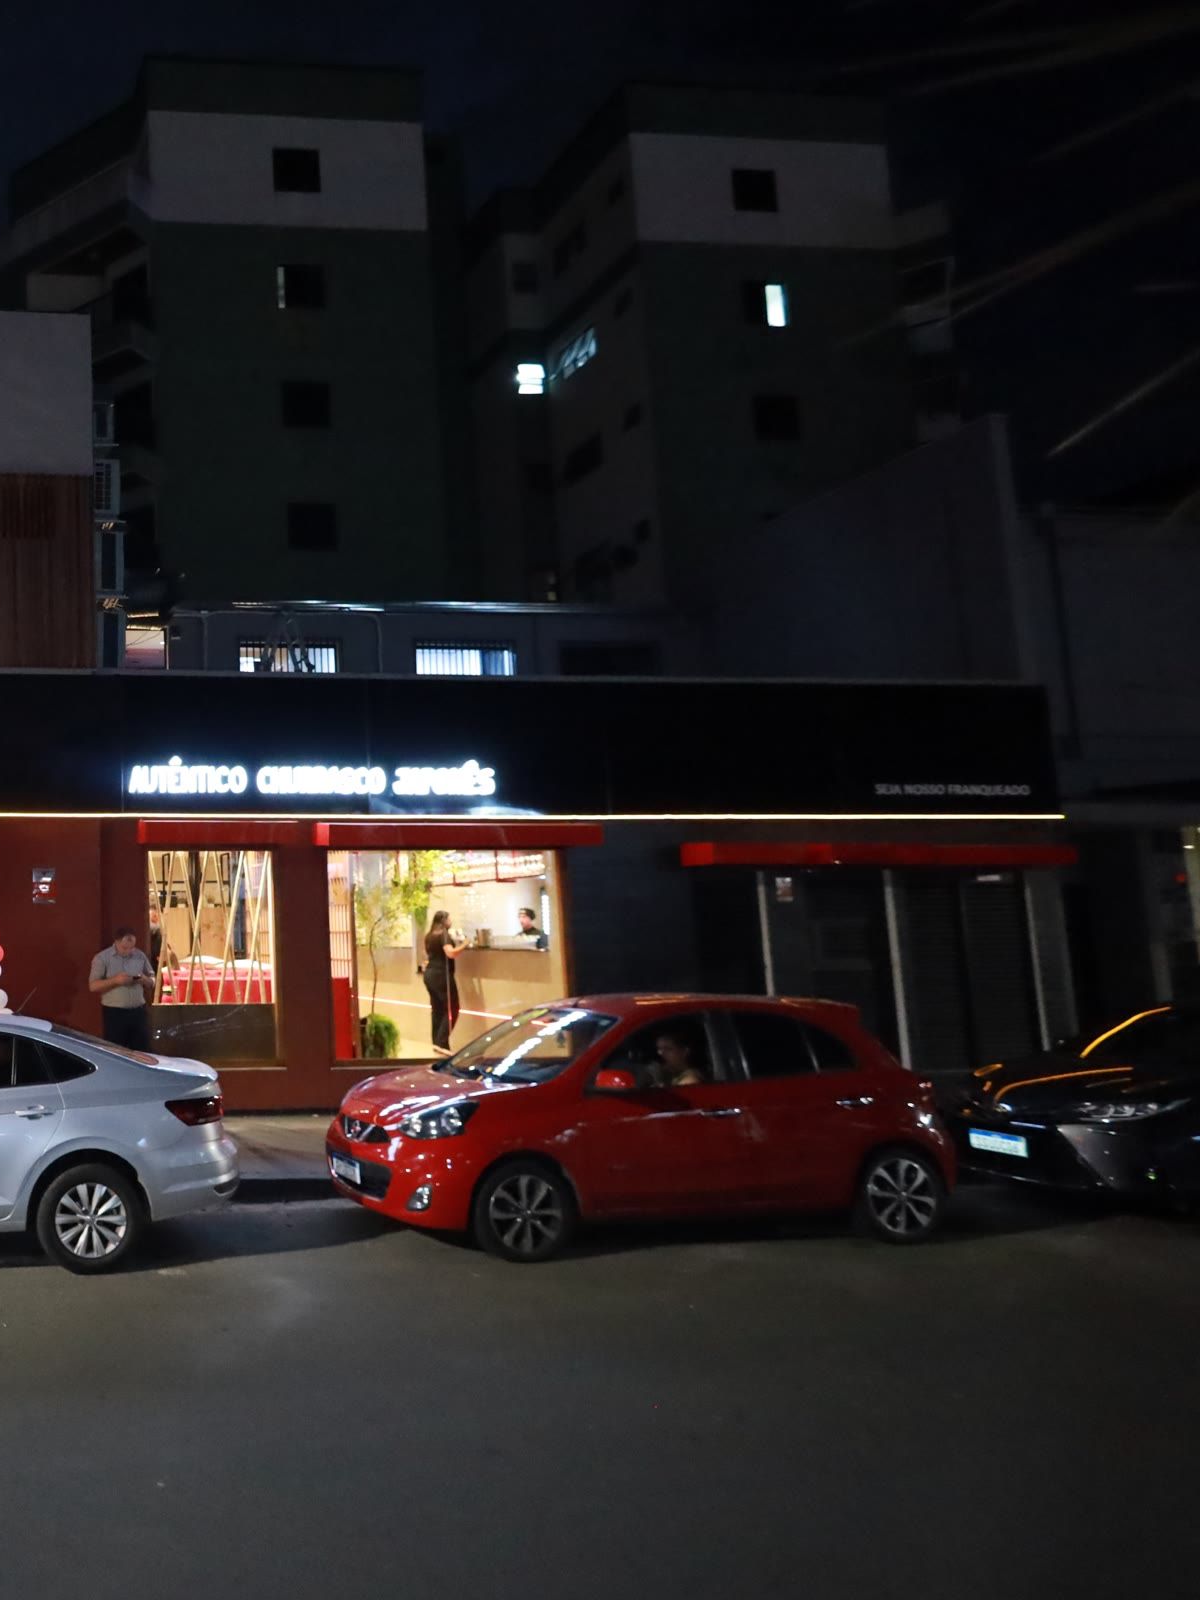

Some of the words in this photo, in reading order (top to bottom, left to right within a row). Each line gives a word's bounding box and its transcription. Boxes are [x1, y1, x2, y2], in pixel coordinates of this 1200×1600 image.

[129, 756, 247, 794] AUTÊNTICO
[256, 766, 387, 795] CHURRASCO
[874, 784, 902, 795] SEJA
[904, 784, 945, 795] NOSSO
[948, 784, 1031, 796] FRANQUEADO
